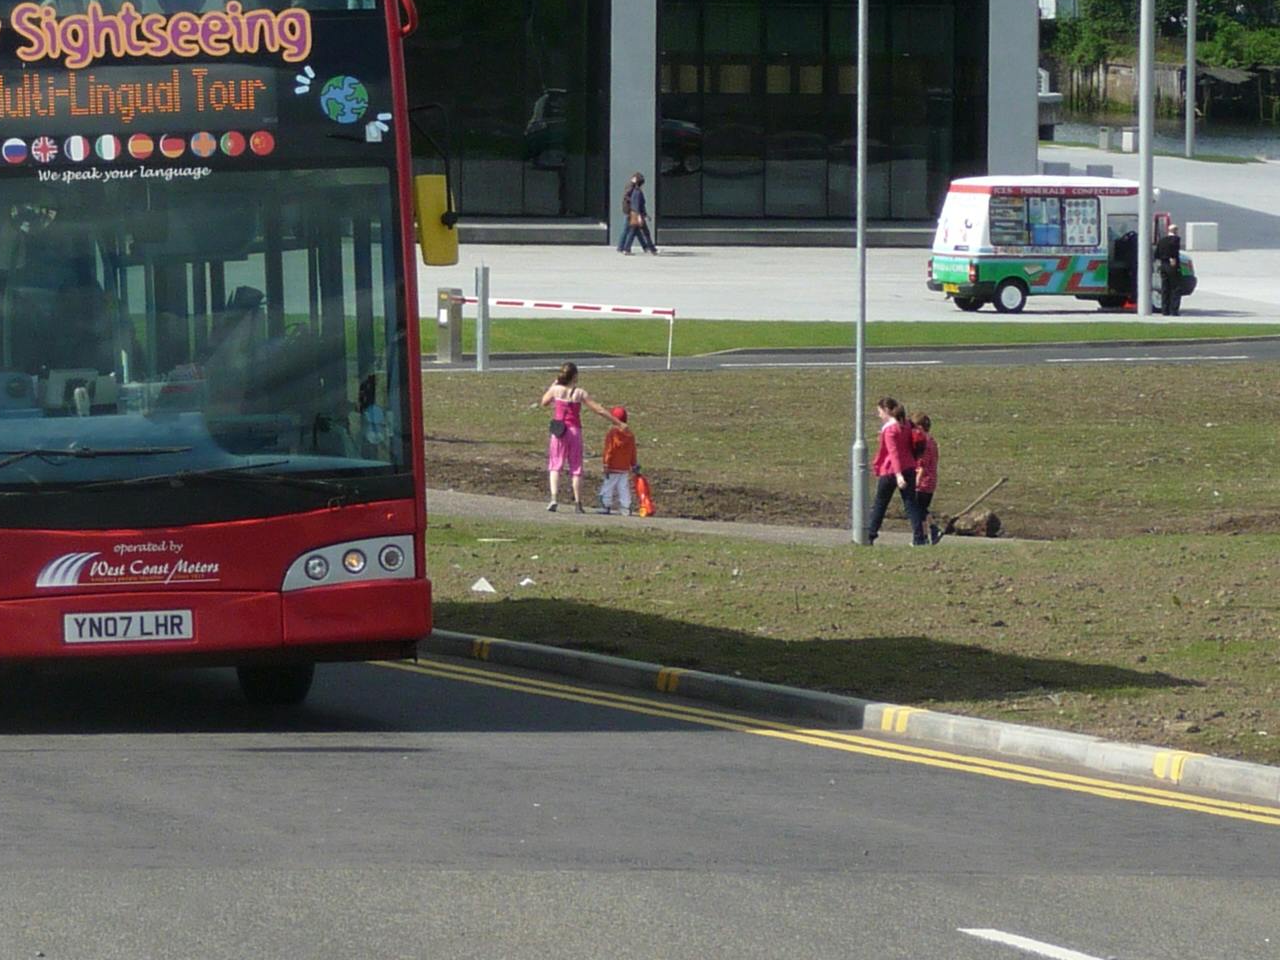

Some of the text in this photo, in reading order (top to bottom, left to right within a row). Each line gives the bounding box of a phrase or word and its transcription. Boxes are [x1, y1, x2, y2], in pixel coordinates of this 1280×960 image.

[11, 0, 312, 68] Sightseeing
[192, 68, 267, 111] Tour
[38, 166, 212, 184] We speak your language
[113, 540, 183, 555] operated by
[90, 560, 125, 576] West
[130, 559, 169, 575] Coast
[165, 558, 220, 584] Motors
[74, 614, 184, 639] YN07 LHR
